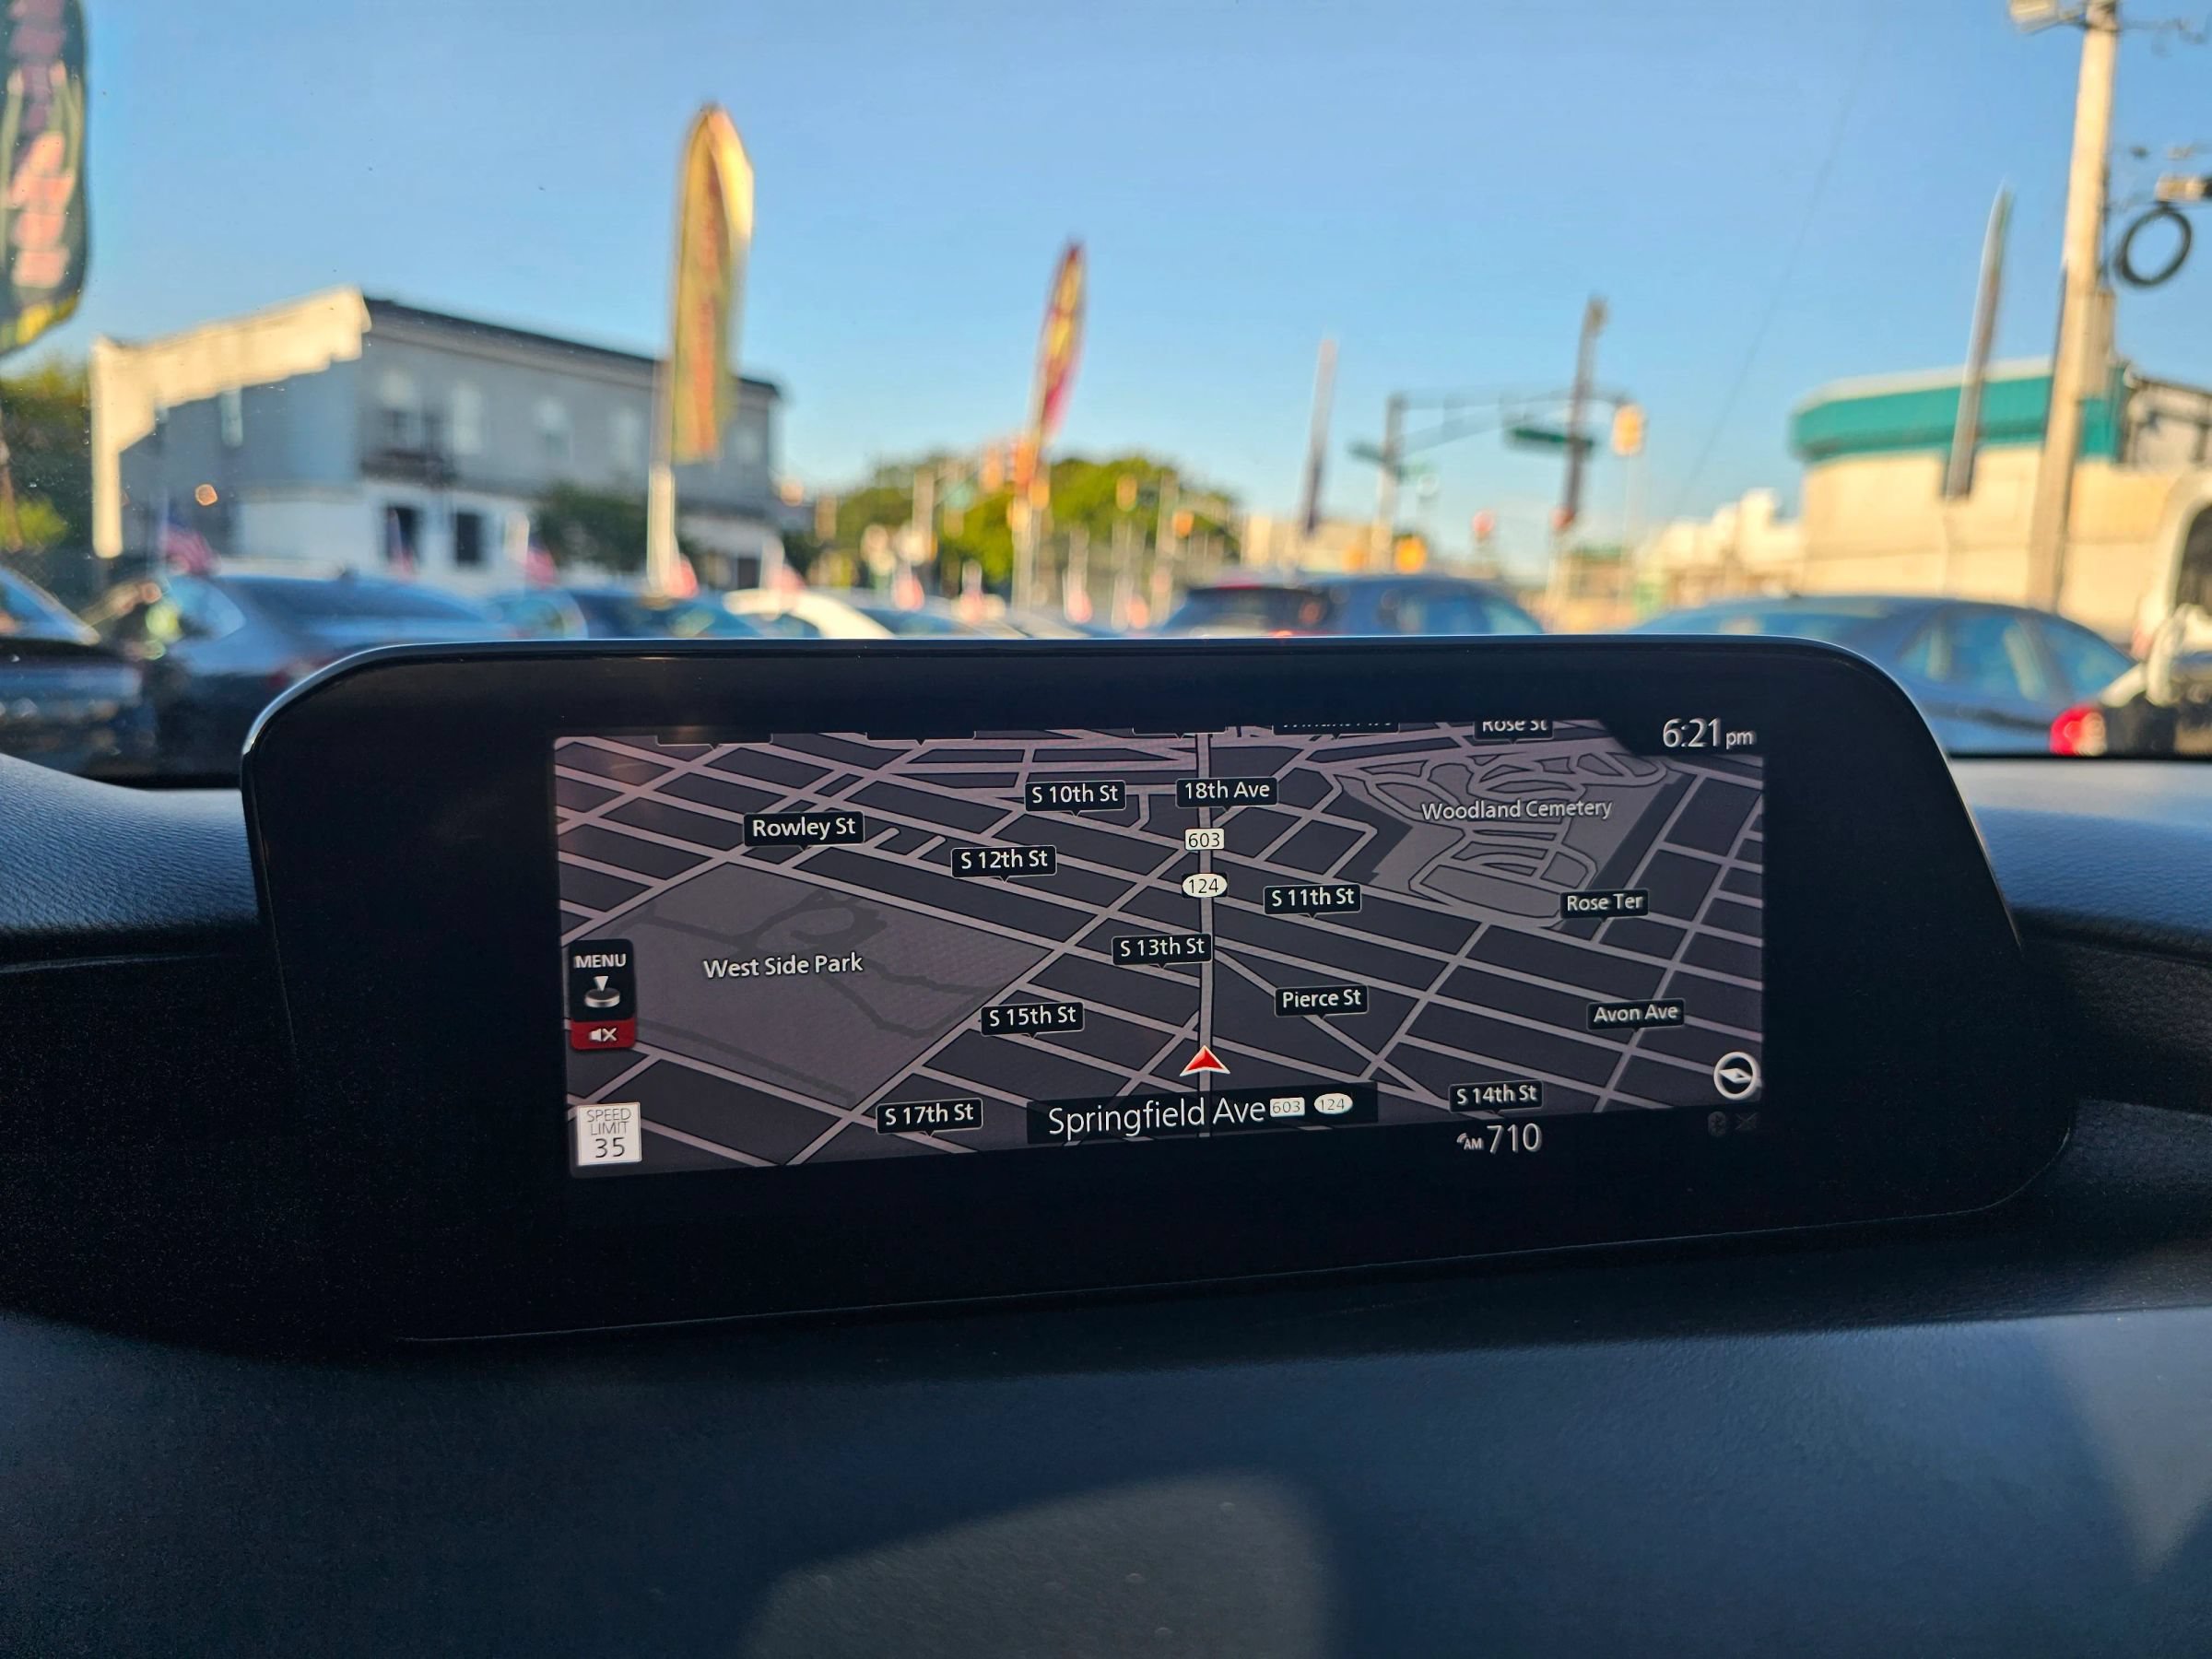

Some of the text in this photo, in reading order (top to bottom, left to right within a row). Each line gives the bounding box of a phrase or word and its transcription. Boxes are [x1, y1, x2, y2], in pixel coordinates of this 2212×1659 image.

[1663, 718, 1754, 749] 6:21 pm
[1032, 783, 1118, 803] S 10th St
[1185, 780, 1270, 799] 18th Ave
[1421, 799, 1613, 820] Woodland Cemetery
[753, 817, 855, 841] Rowley St
[1188, 832, 1220, 848] 603
[961, 849, 1048, 869] S 12th St
[1187, 878, 1219, 894] 124
[1271, 887, 1355, 907] S 11th St
[1567, 894, 1642, 912] Rose Ter
[1120, 936, 1205, 957] S 13th St
[575, 953, 627, 969] MENU
[704, 953, 862, 979] West Side Park
[1282, 990, 1361, 1009] Pierce St
[989, 1005, 1076, 1027] S 15th St
[1594, 1004, 1678, 1022] Avon Ave
[1456, 1084, 1537, 1103] S 14th St
[586, 1108, 631, 1123] SPEED
[885, 1104, 973, 1124] S 17th St
[1048, 1096, 1346, 1141] Springfield Ave 603 124
[591, 1121, 627, 1135] LIMIT
[594, 1137, 625, 1158] 35
[1464, 1124, 1541, 1154] AM 710
